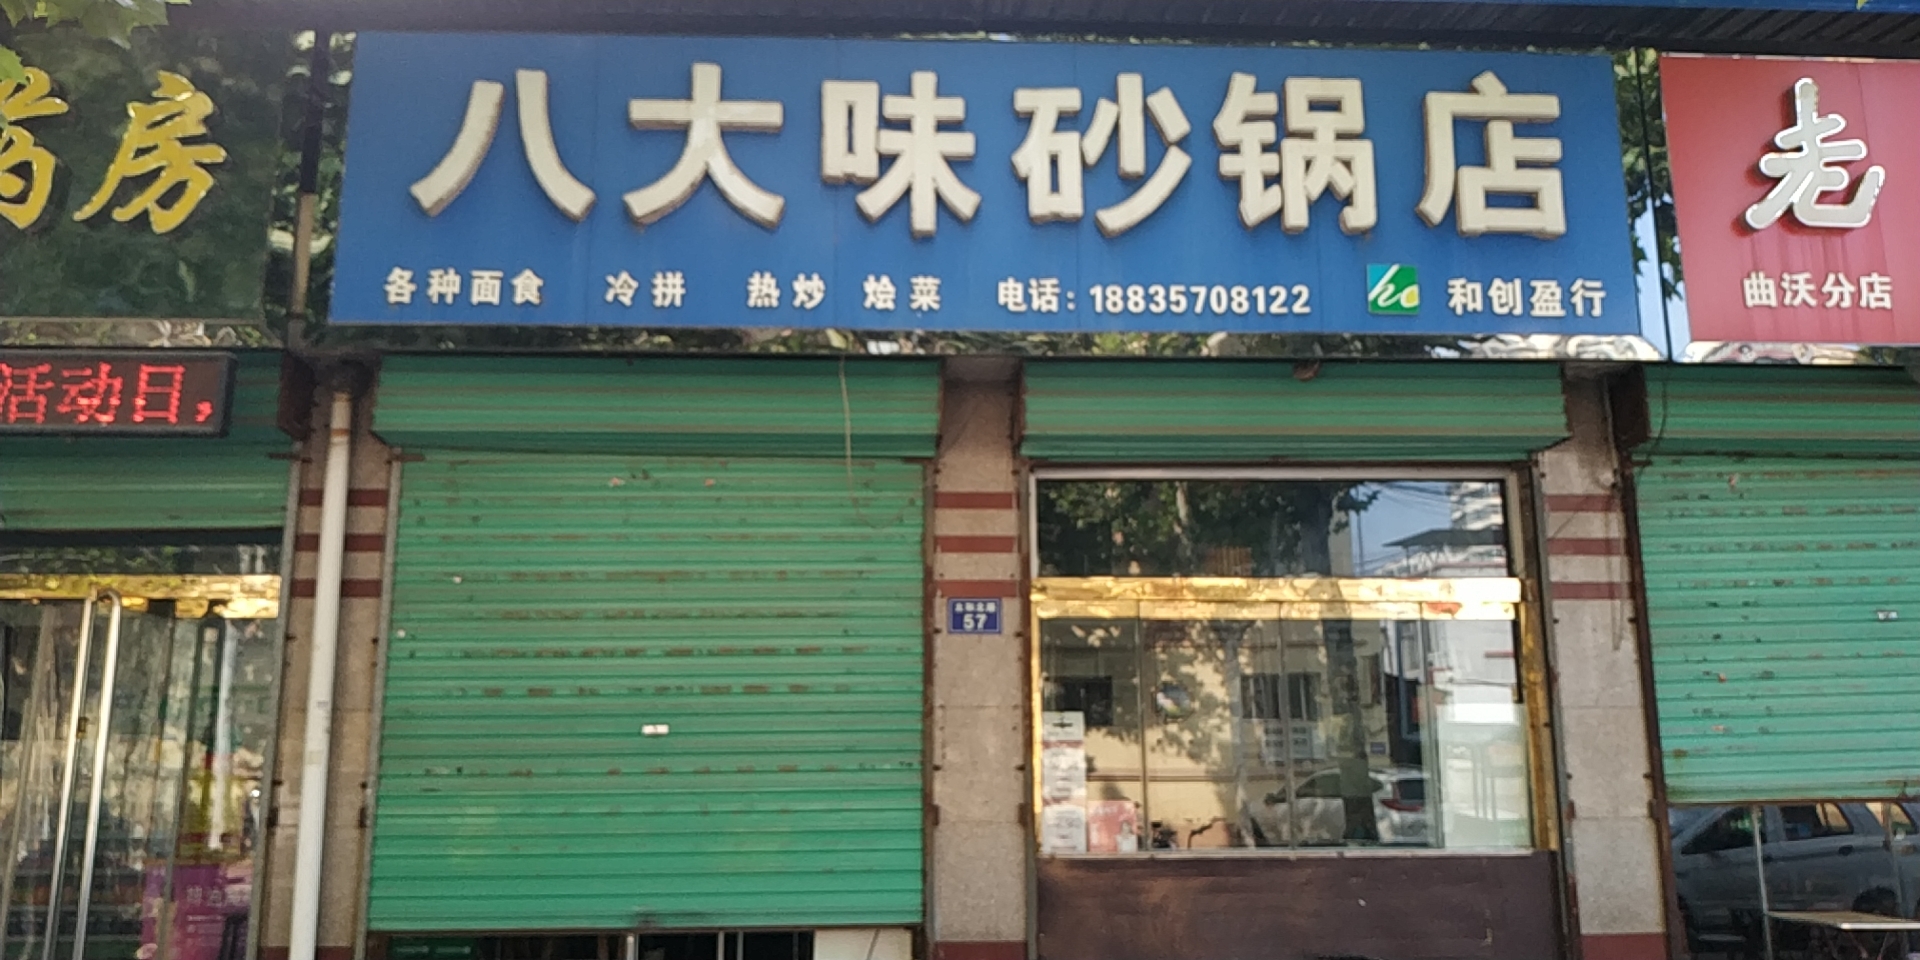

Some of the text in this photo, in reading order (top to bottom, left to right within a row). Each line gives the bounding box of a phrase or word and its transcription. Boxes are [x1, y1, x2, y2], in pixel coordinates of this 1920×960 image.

[410, 62, 1567, 238] 八大味砂锅店
[1744, 77, 1886, 229] 老
[383, 266, 545, 305] 各种面食
[603, 270, 687, 308] 冷拼
[746, 271, 827, 310] 热炒
[862, 274, 942, 312] 烩菜
[1447, 277, 1607, 318] 和创盈行
[1742, 271, 1893, 310] 曲沃分店
[963, 613, 988, 632] 57
